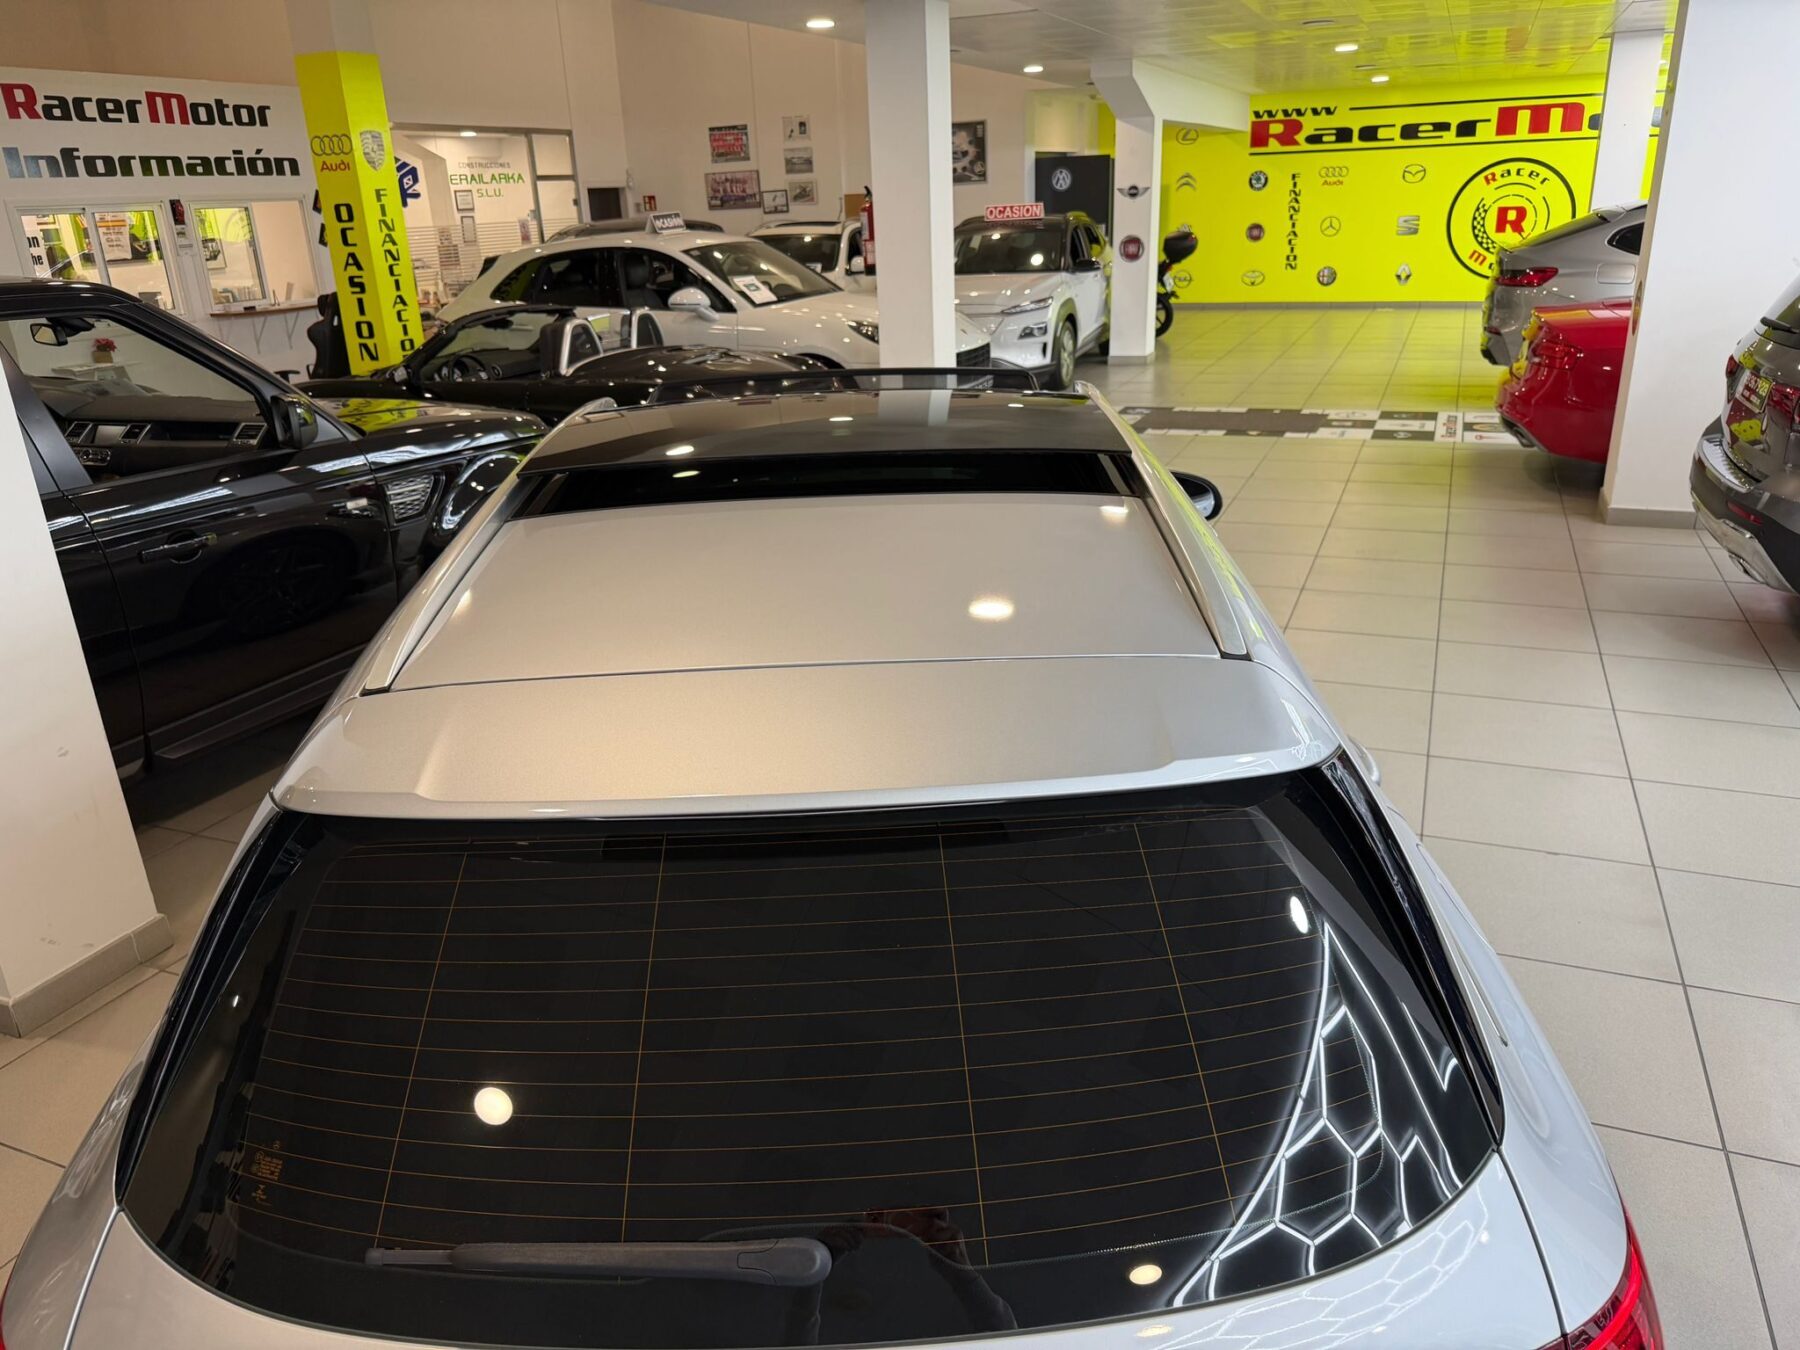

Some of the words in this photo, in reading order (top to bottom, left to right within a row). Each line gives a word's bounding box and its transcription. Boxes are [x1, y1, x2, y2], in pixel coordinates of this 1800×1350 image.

[0, 82, 271, 128] RacerMotor
[2, 147, 301, 179] Información
[320, 160, 351, 173] Audi
[1484, 167, 1550, 186] Racer
[450, 173, 525, 185] ERAILARKA
[477, 188, 505, 199] S.L.U.
[986, 205, 1041, 220] OCASION
[1285, 173, 1301, 270] FINANCIACION
[1495, 206, 1528, 233] R
[334, 203, 379, 361] OCASION
[374, 189, 416, 359] FINANCIACIO
